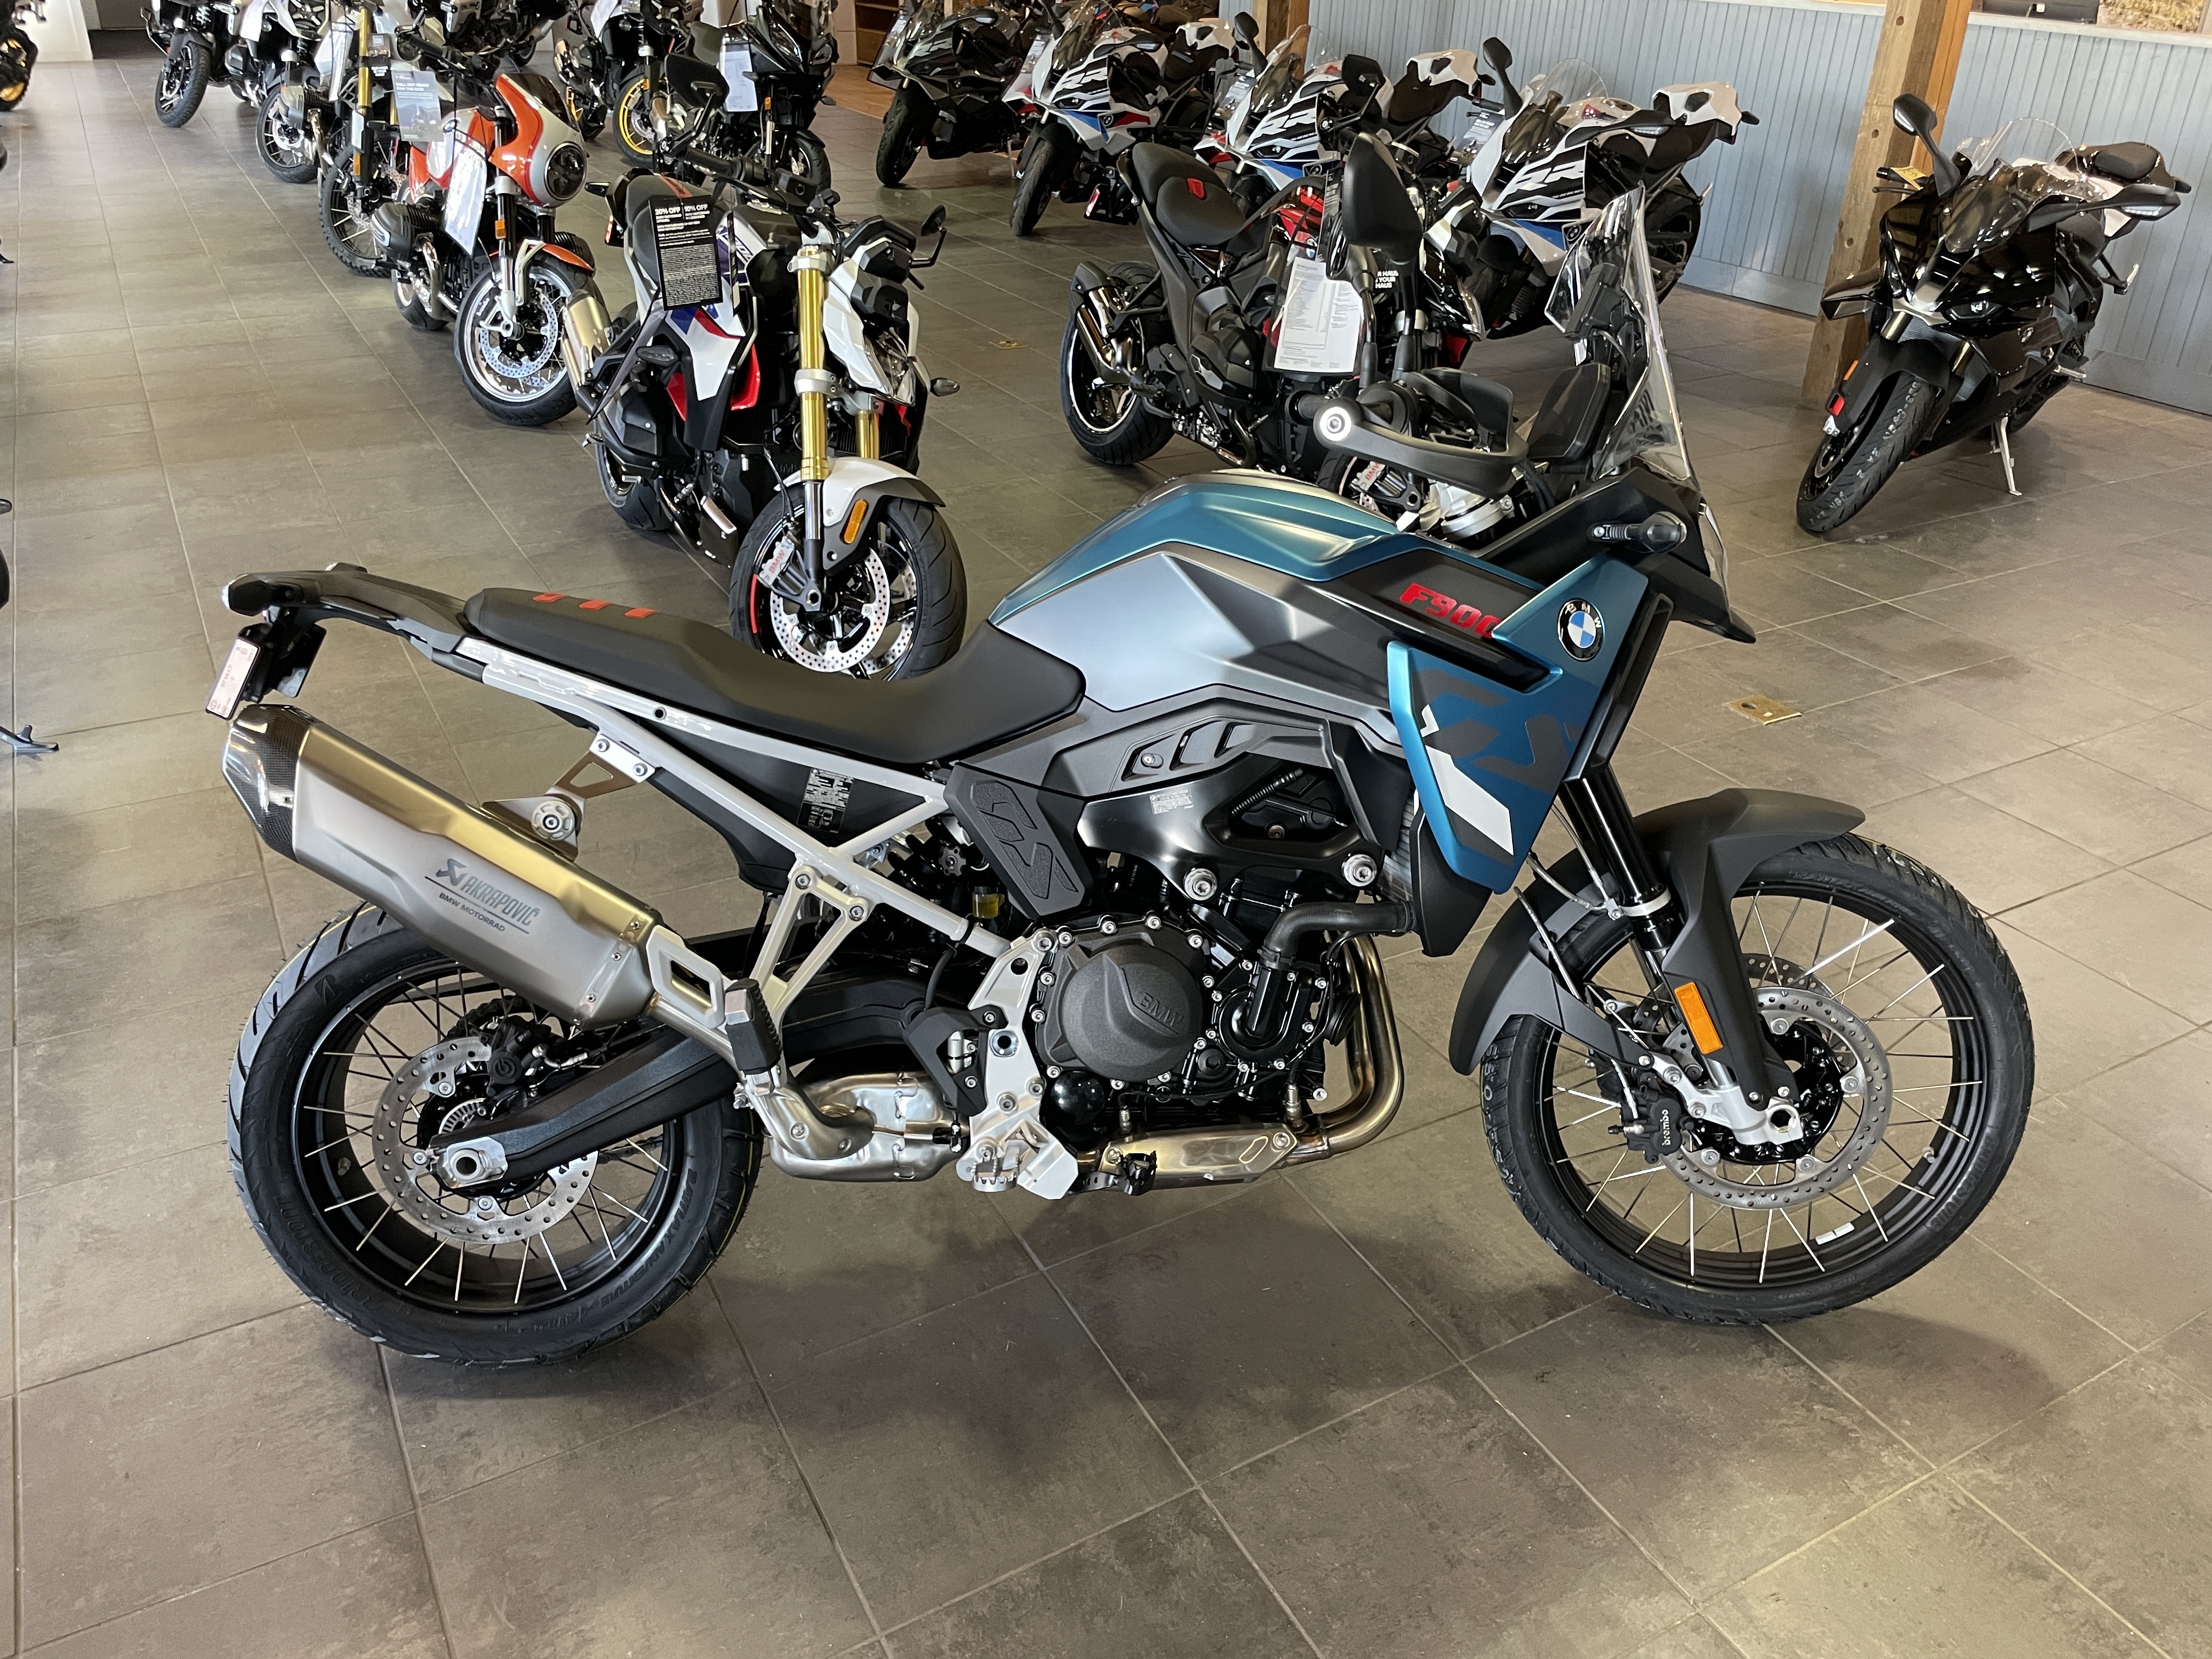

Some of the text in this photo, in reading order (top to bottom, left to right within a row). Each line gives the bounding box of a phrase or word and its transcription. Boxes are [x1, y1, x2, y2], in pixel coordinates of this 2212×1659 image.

[769, 549, 785, 574] BMW
[439, 892, 506, 932] BMW MOTORRAD
[1137, 992, 1184, 1026] BMW
[1660, 1109, 1671, 1146] brembo
